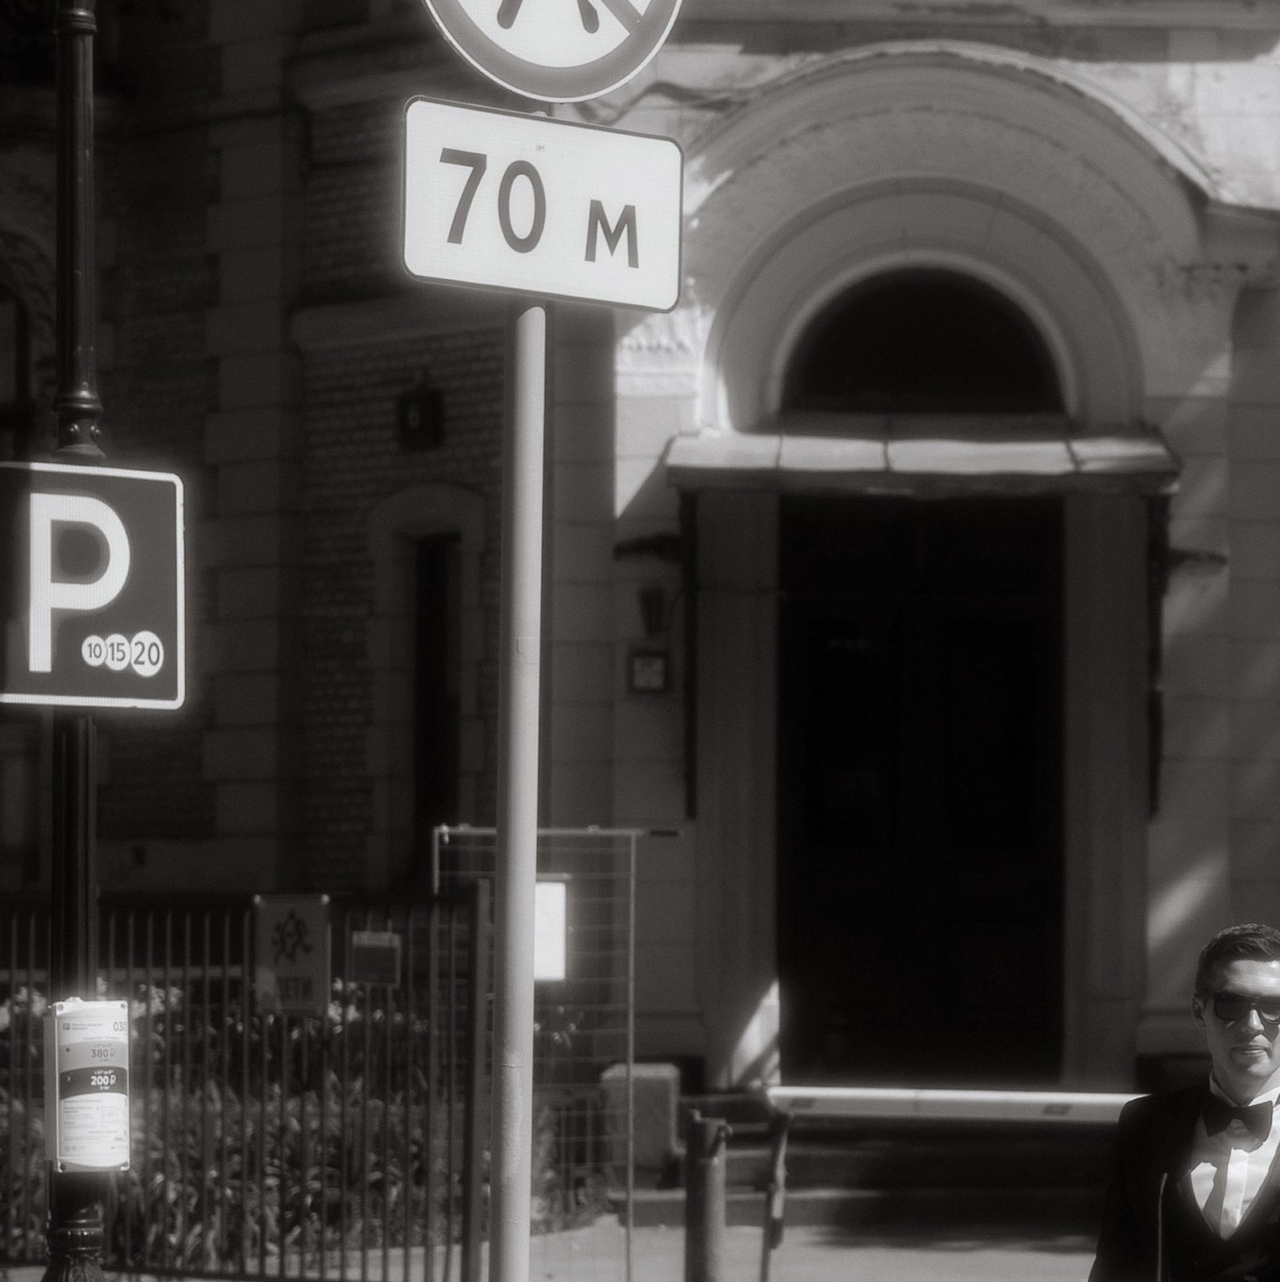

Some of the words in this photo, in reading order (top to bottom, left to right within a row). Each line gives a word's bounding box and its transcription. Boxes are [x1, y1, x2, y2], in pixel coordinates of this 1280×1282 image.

[438, 146, 547, 254] 70
[29, 492, 131, 673] P
[87, 642, 102, 659] 10
[109, 642, 126, 662] 15
[133, 641, 161, 666] 20
